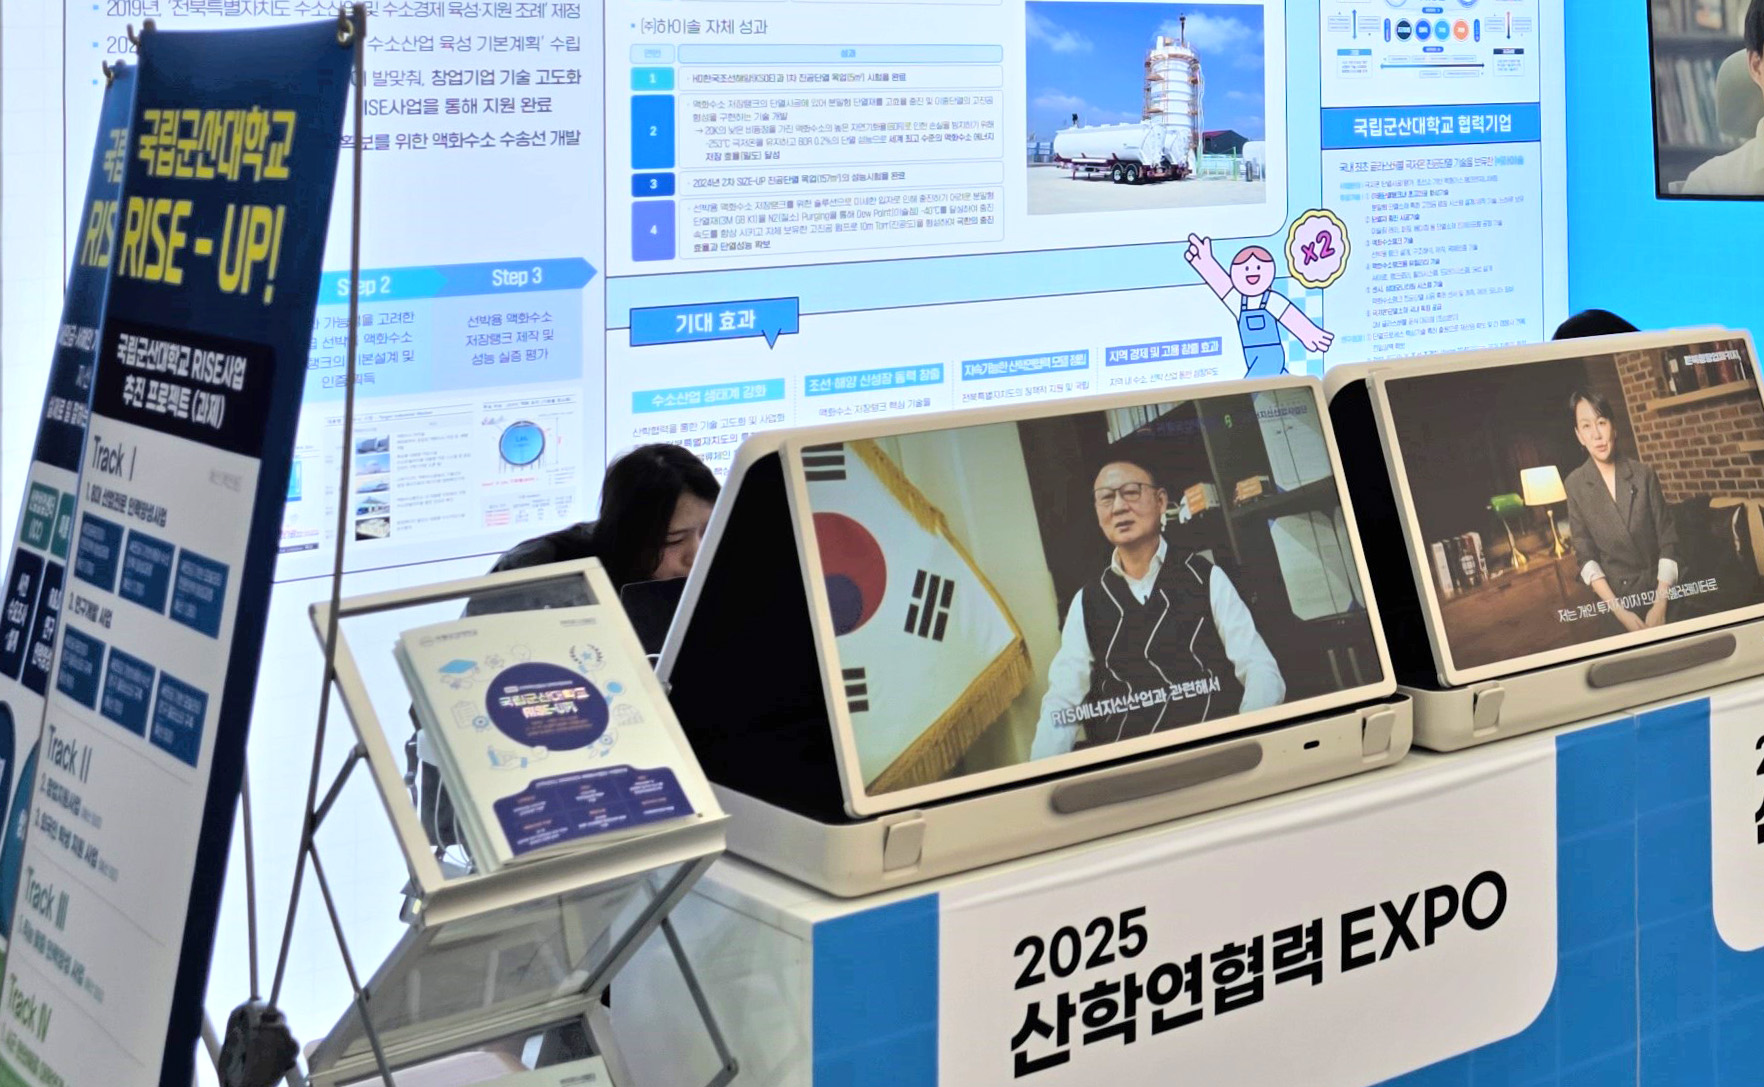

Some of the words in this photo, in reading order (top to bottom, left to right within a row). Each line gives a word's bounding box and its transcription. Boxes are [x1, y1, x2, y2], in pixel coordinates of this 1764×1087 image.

[383, 0, 445, 19] 수소경제
[551, 1, 581, 20] 제정
[705, 18, 735, 34] 자체
[739, 18, 768, 34] 성과
[368, 36, 434, 53] 수소산업
[440, 34, 472, 53] 육성
[550, 34, 581, 53] 수립
[431, 68, 495, 87] 창업기업
[499, 68, 531, 87] 기술
[535, 69, 582, 87] 고도화
[444, 97, 478, 116] 통해
[483, 97, 516, 116] 지원
[520, 96, 552, 114] 완료
[1354, 116, 1454, 137] 국립군산대학교
[1458, 114, 1512, 133] 협력기업
[138, 107, 296, 181] 국립군산대학교
[395, 131, 429, 150] 위한
[432, 130, 495, 149] 액화수소
[499, 129, 546, 148] 수송선
[549, 129, 581, 147] 개발
[118, 197, 193, 286] RISE
[218, 204, 286, 305] UP!
[337, 278, 376, 296] Sep
[380, 276, 391, 293] 2
[492, 268, 529, 286] Step
[532, 267, 543, 285] 3
[378, 311, 415, 326] 고려한
[467, 313, 503, 327] 선박용
[506, 310, 553, 325] 액화수소
[675, 311, 712, 332] 기대
[718, 308, 756, 331] 효과
[364, 330, 413, 345] 액화수소
[465, 332, 513, 347] 저장탱크
[516, 330, 539, 345] 제작
[472, 352, 495, 366] 성능
[499, 350, 522, 364] 실증
[525, 348, 549, 362] 평가
[1109, 350, 1128, 362] 지역
[1201, 341, 1219, 353] 효과
[116, 333, 191, 377] 국립군산대학교
[191, 349, 247, 391] RISE사업
[860, 373, 892, 387] 신성장
[122, 374, 146, 408] 추진
[145, 380, 192, 419] 프로젝트
[191, 389, 226, 429] (과제)
[651, 390, 700, 407] 수소산업
[704, 387, 739, 403] 생태계
[92, 435, 124, 477] Track
[1557, 608, 1578, 623] 저는
[1577, 604, 1597, 619] 개인
[1051, 686, 1168, 727] RIS에너지신산업과
[1169, 676, 1221, 705] 관련해서
[48, 725, 77, 776] Track
[25, 866, 54, 921] Track
[1013, 905, 1149, 991] 2025
[1010, 916, 1324, 1079] 산학연협력
[1340, 870, 1508, 973] EXPO
